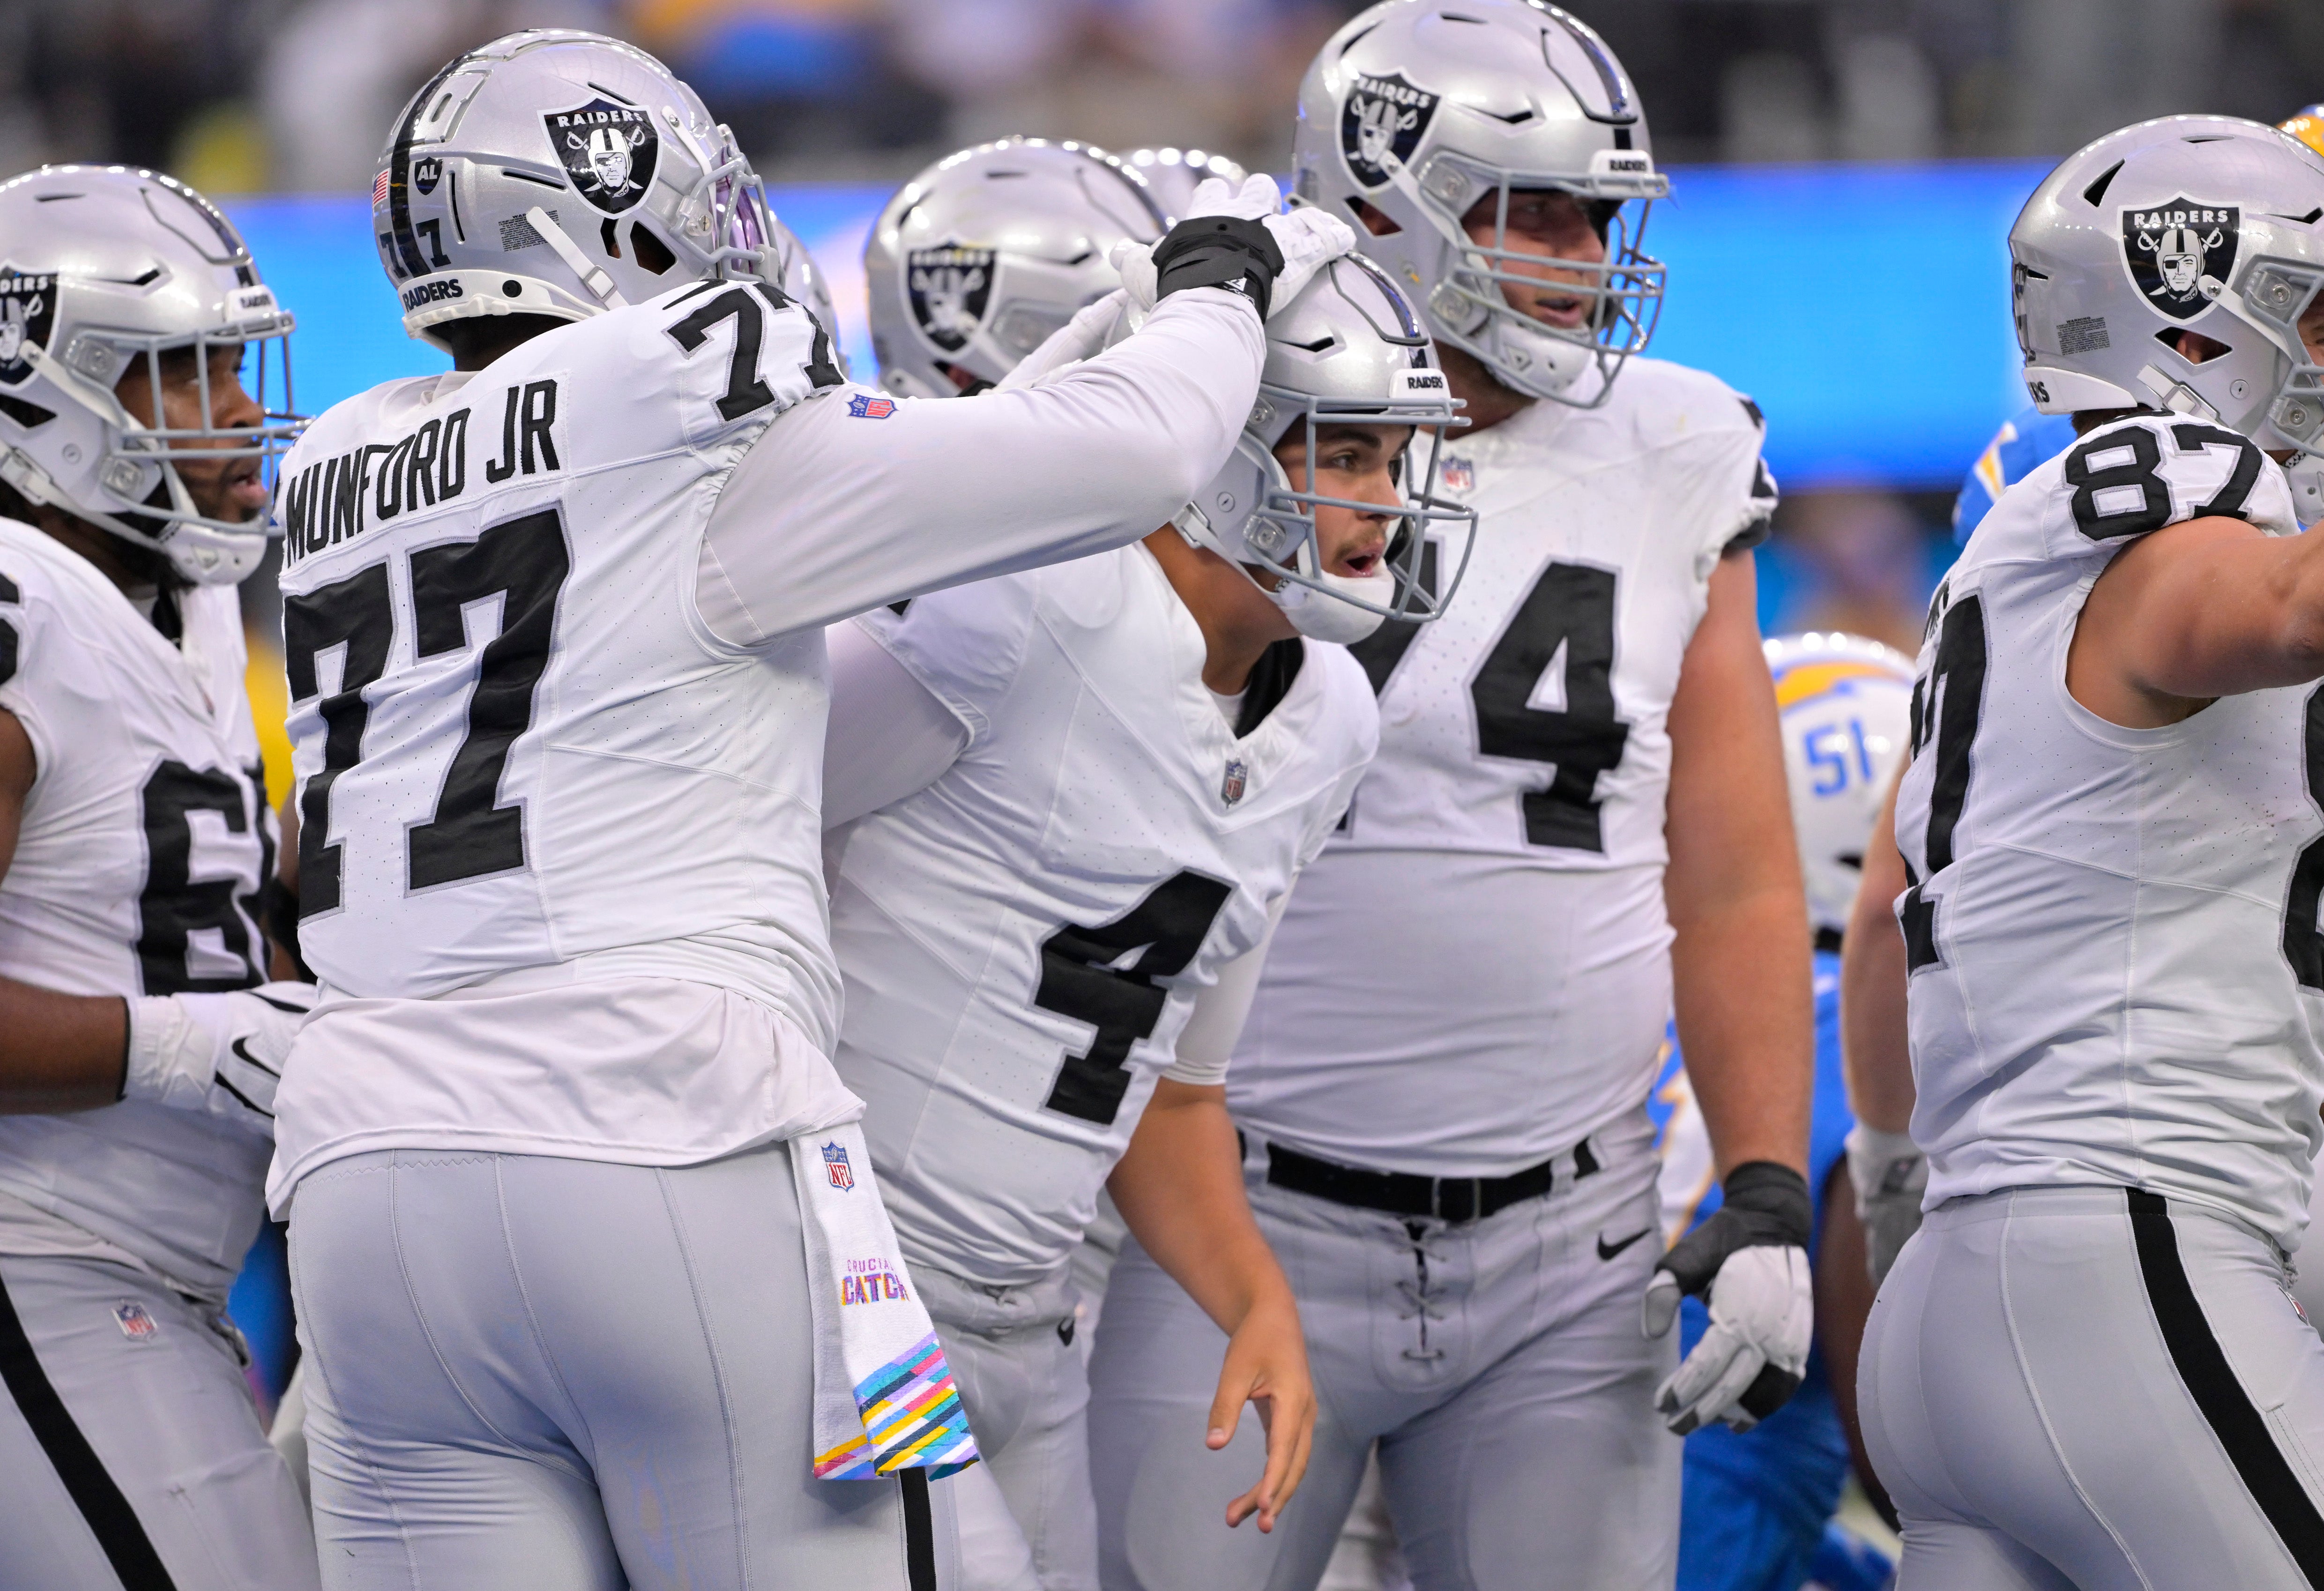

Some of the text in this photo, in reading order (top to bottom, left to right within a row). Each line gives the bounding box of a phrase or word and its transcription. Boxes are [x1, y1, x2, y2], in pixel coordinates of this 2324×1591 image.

[557, 110, 643, 127] RAIDERS
[417, 165, 438, 181] AL
[2134, 210, 2228, 226] RAIDERS
[402, 279, 463, 313] RAIDERS
[661, 283, 846, 429] 77
[2027, 381, 2050, 403] RS
[866, 401, 892, 418] NFL
[285, 378, 560, 568] MUNFORD JR
[2062, 418, 2267, 545] 87
[283, 499, 576, 930] 77
[1802, 718, 1873, 797] 51
[1032, 867, 1240, 1131] 4
[829, 1161, 852, 1188] NFL
[847, 1258, 894, 1273] CRUCIAL
[841, 1272, 911, 1306] CATCH
